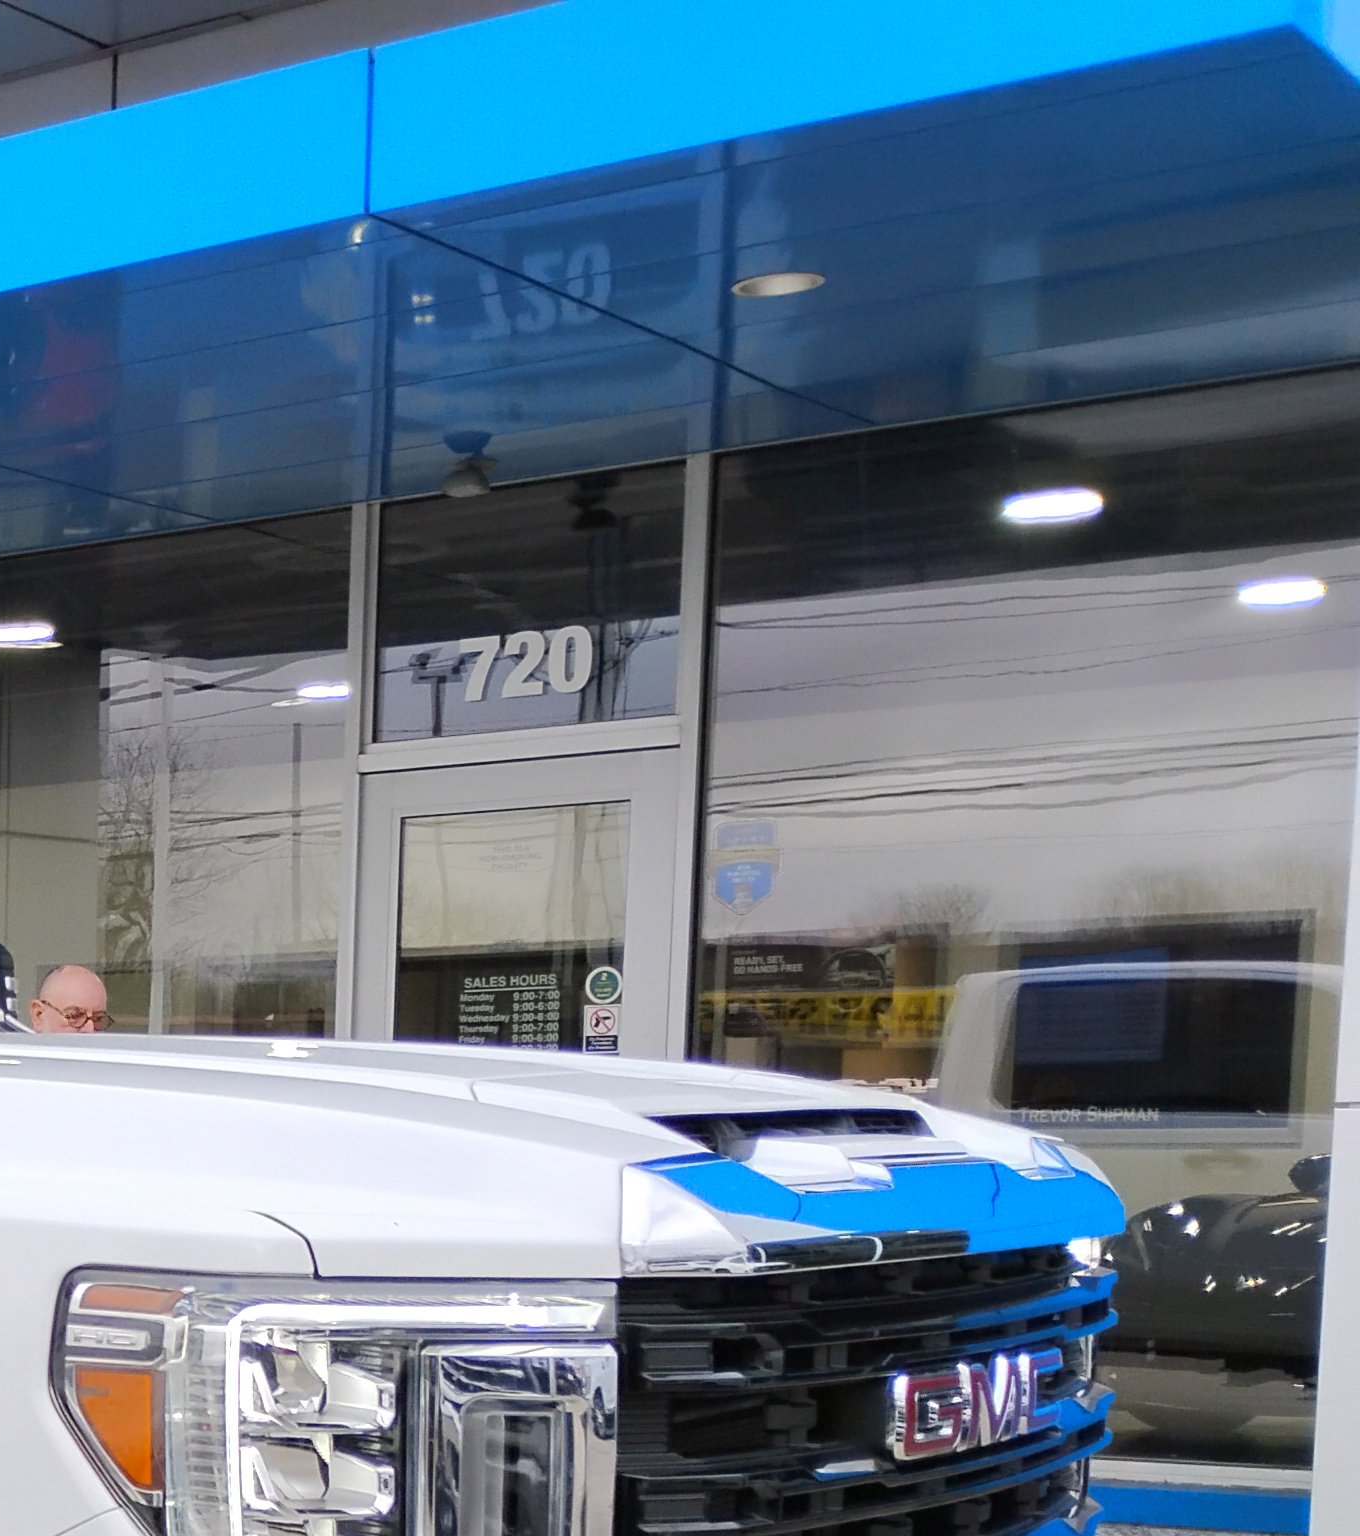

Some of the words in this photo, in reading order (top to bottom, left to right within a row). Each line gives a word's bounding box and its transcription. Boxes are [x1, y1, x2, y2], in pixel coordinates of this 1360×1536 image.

[459, 625, 592, 702] 720
[464, 976, 507, 988] SALES
[510, 973, 557, 986] HOURS
[460, 994, 495, 1002] Monday
[513, 991, 560, 1001] 9:00-7:00
[460, 1004, 495, 1013] Tuesday
[459, 1014, 510, 1023] Wednesday
[459, 1025, 499, 1034] Thursday
[893, 1347, 1064, 1460] GMC
